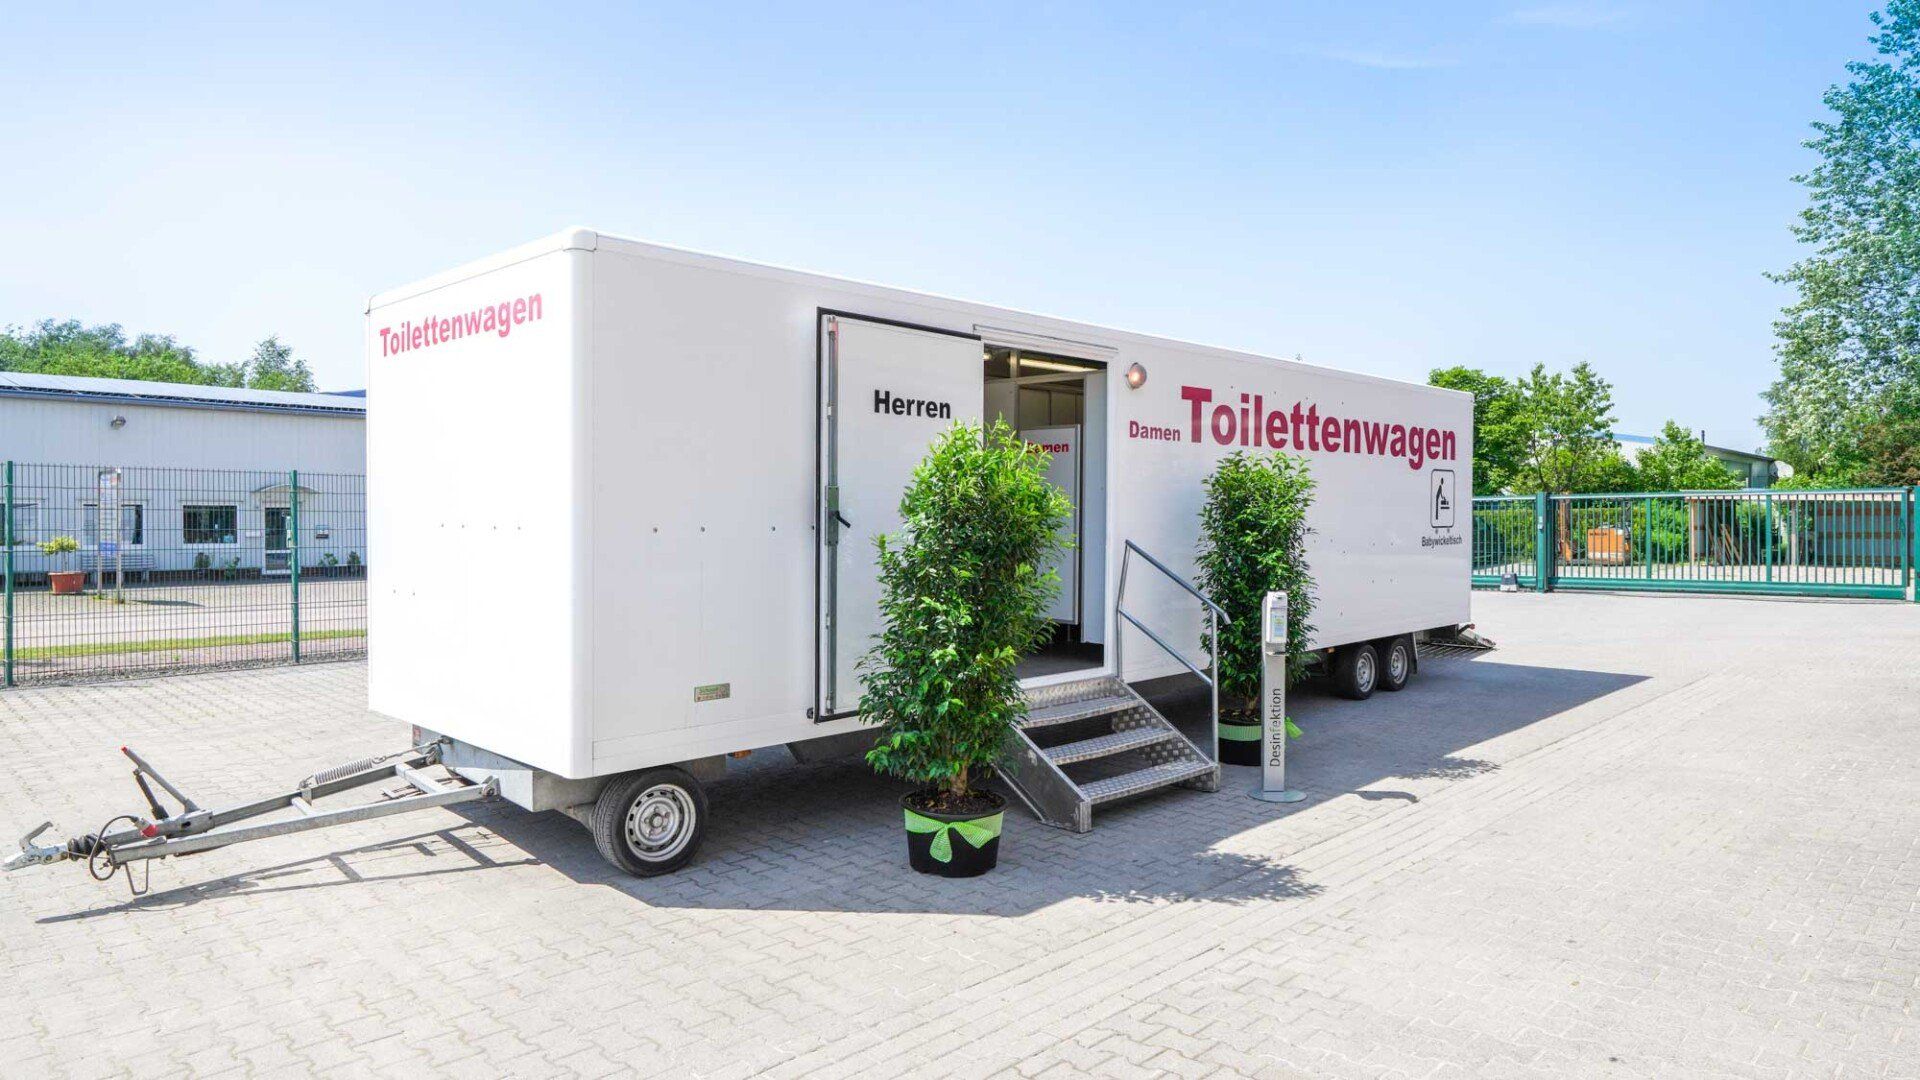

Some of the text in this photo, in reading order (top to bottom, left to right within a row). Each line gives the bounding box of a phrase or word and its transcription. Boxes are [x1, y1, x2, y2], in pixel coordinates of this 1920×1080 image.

[380, 293, 542, 357] Toilettenwagen
[874, 389, 951, 419] Herren
[1181, 385, 1456, 470] Toilettenwagen
[1129, 420, 1181, 441] Damen
[1421, 535, 1462, 549] Babywickeltisch
[1269, 688, 1281, 767] Desinfektion
